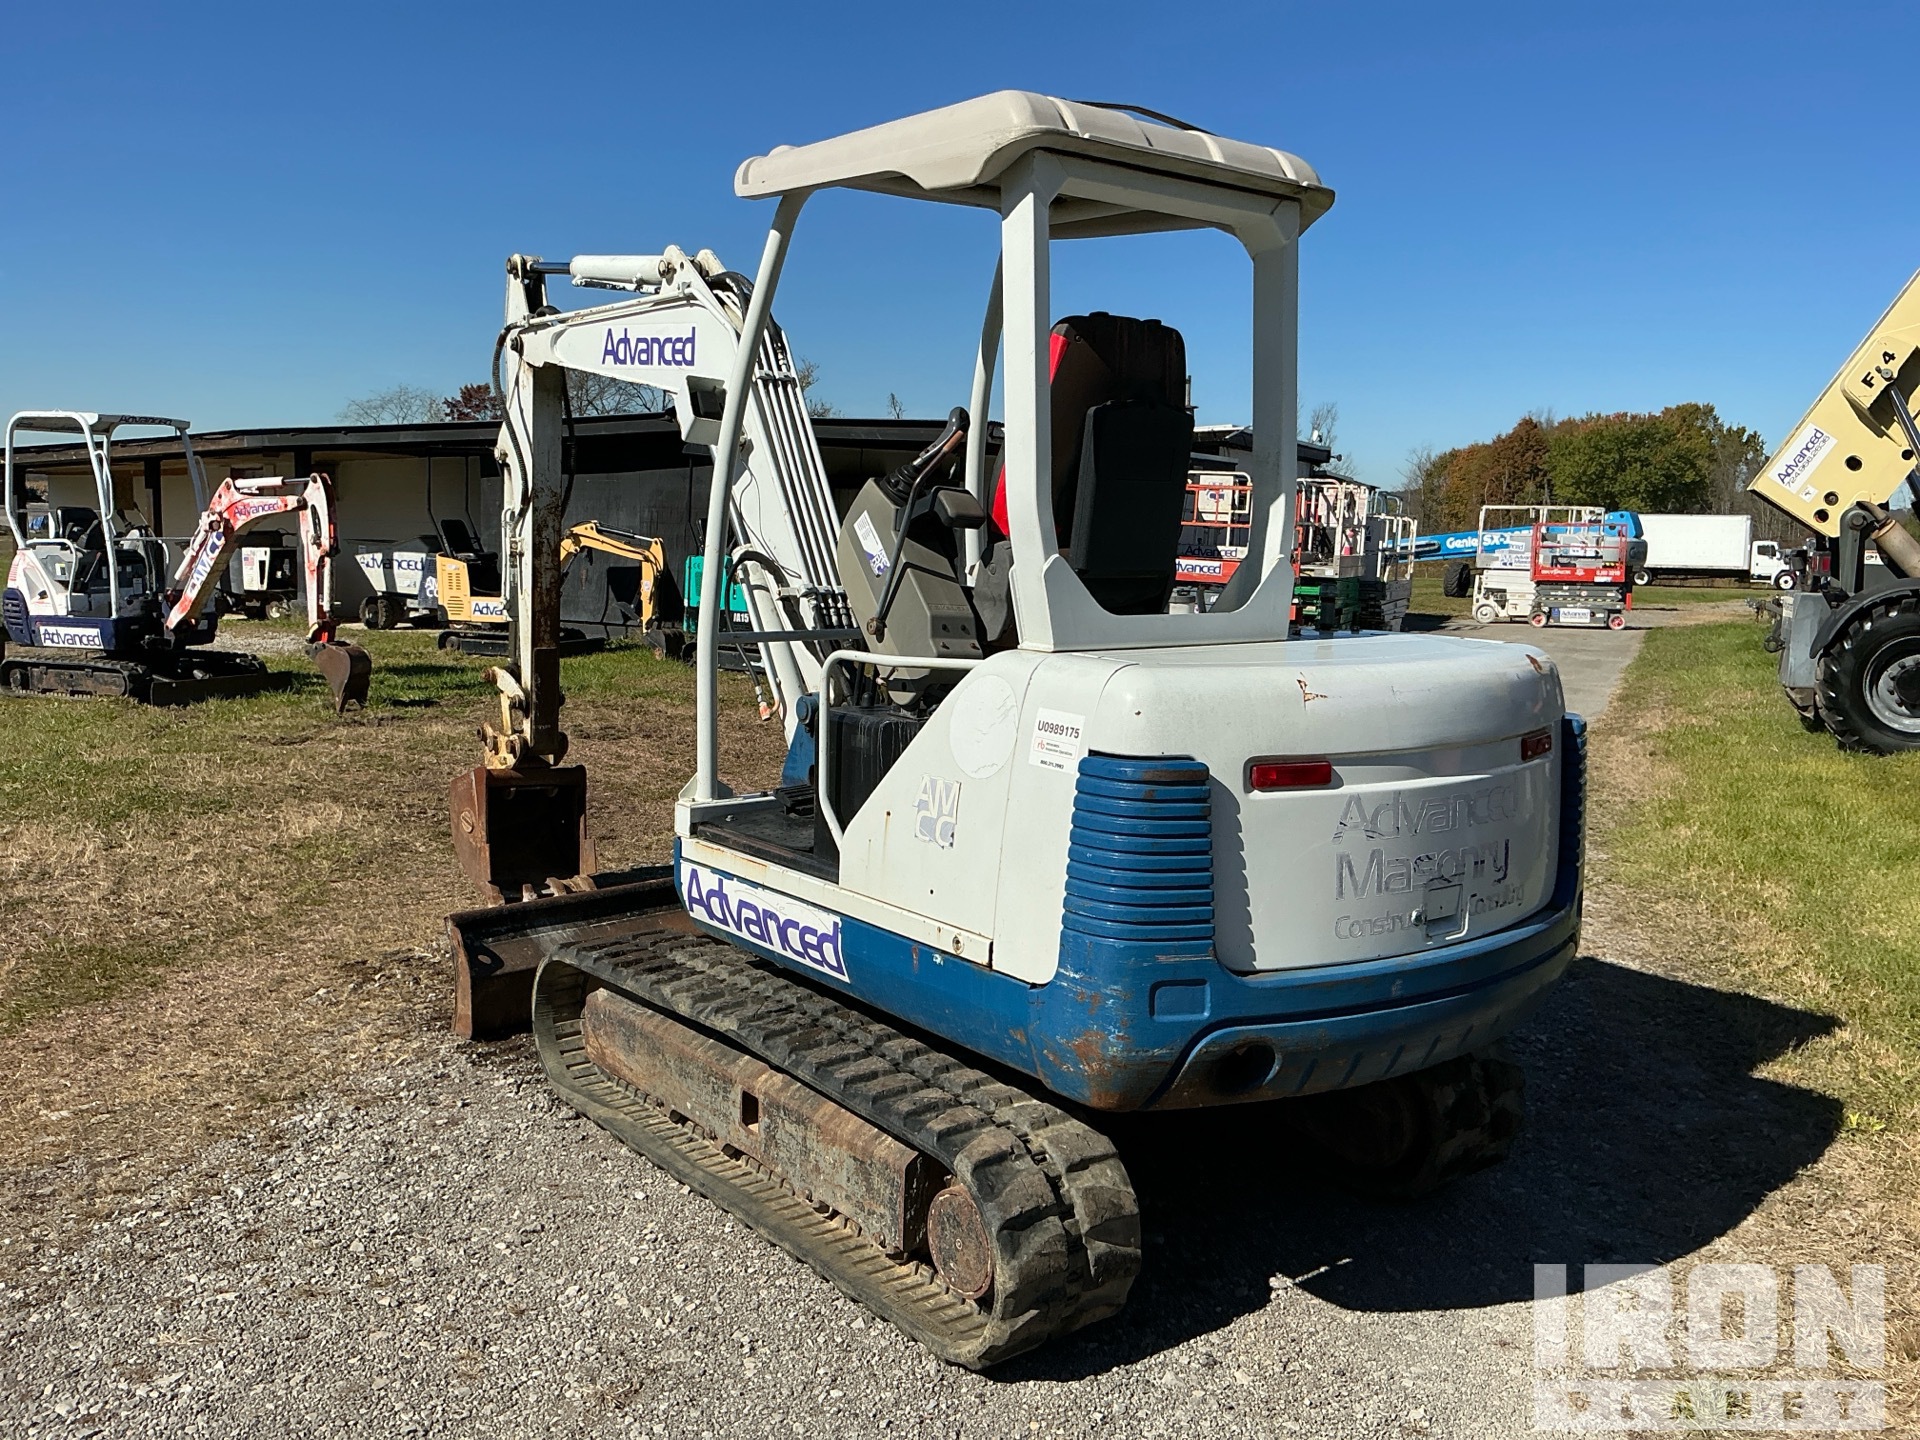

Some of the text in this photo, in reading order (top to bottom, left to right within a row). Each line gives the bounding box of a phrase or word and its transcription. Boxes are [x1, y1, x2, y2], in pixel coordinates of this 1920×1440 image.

[602, 326, 696, 366] Advanced
[1882, 350, 1897, 366] 4
[1777, 428, 1825, 485] Advanced
[233, 502, 279, 518] Advanced
[1184, 545, 1238, 558] Advanced
[1446, 536, 1479, 549] Genie
[472, 602, 504, 616] Adva
[43, 628, 102, 647] Advanced
[1037, 719, 1080, 739] U0989175
[1332, 776, 1519, 845] Advanced
[1335, 838, 1510, 901] Masonry
[687, 867, 847, 977] Advanced
